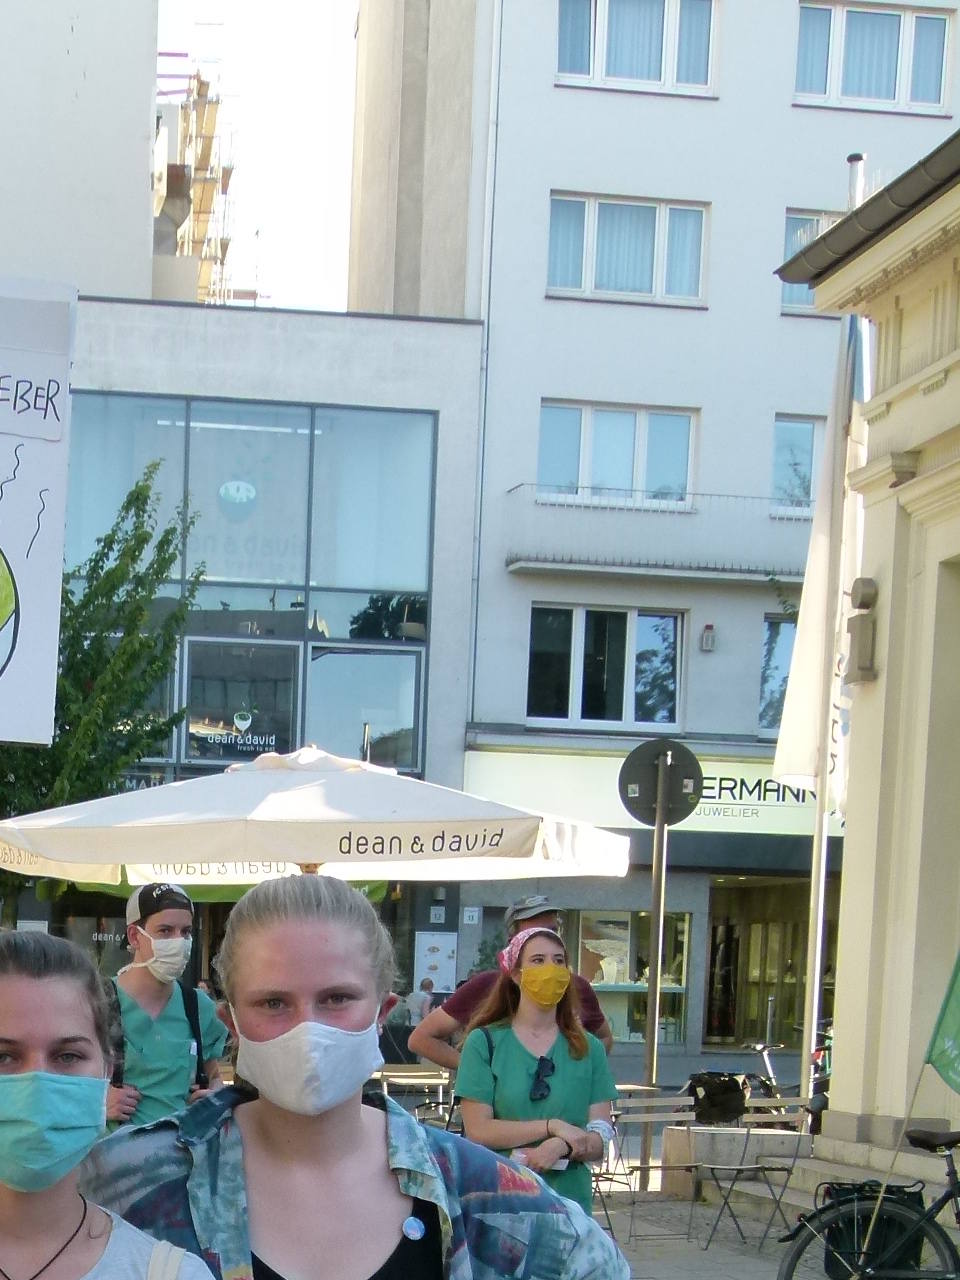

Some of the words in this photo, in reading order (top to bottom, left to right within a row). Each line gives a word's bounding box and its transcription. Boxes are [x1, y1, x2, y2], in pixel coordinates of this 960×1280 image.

[207, 734, 235, 744] dean
[237, 735, 244, 744] &
[245, 733, 276, 745] david
[695, 807, 760, 818] JUWELIER
[339, 831, 402, 855] dean
[410, 836, 425, 854] &
[431, 828, 504, 852] david
[92, 931, 114, 941] dean
